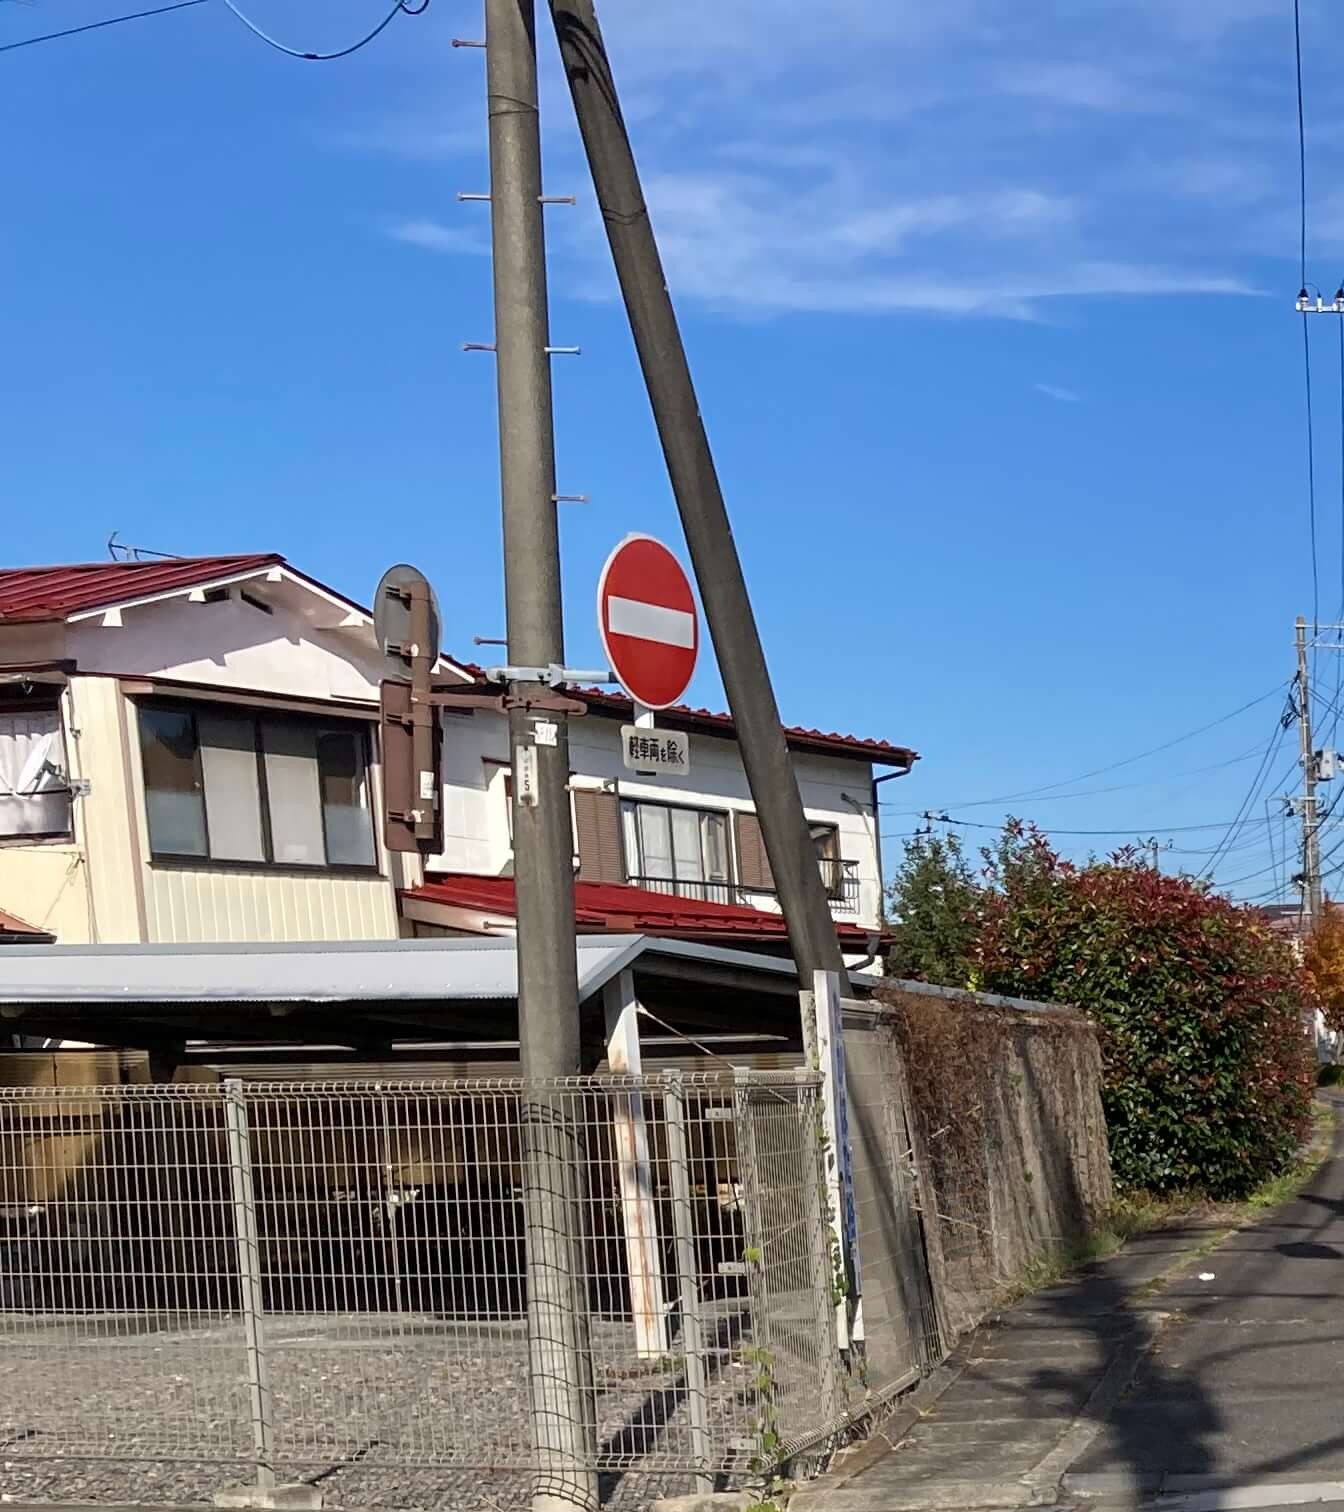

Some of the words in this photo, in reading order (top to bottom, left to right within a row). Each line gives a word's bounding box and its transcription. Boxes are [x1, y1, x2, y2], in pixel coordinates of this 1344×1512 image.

[629, 736, 685, 764] 軽車両を除く
